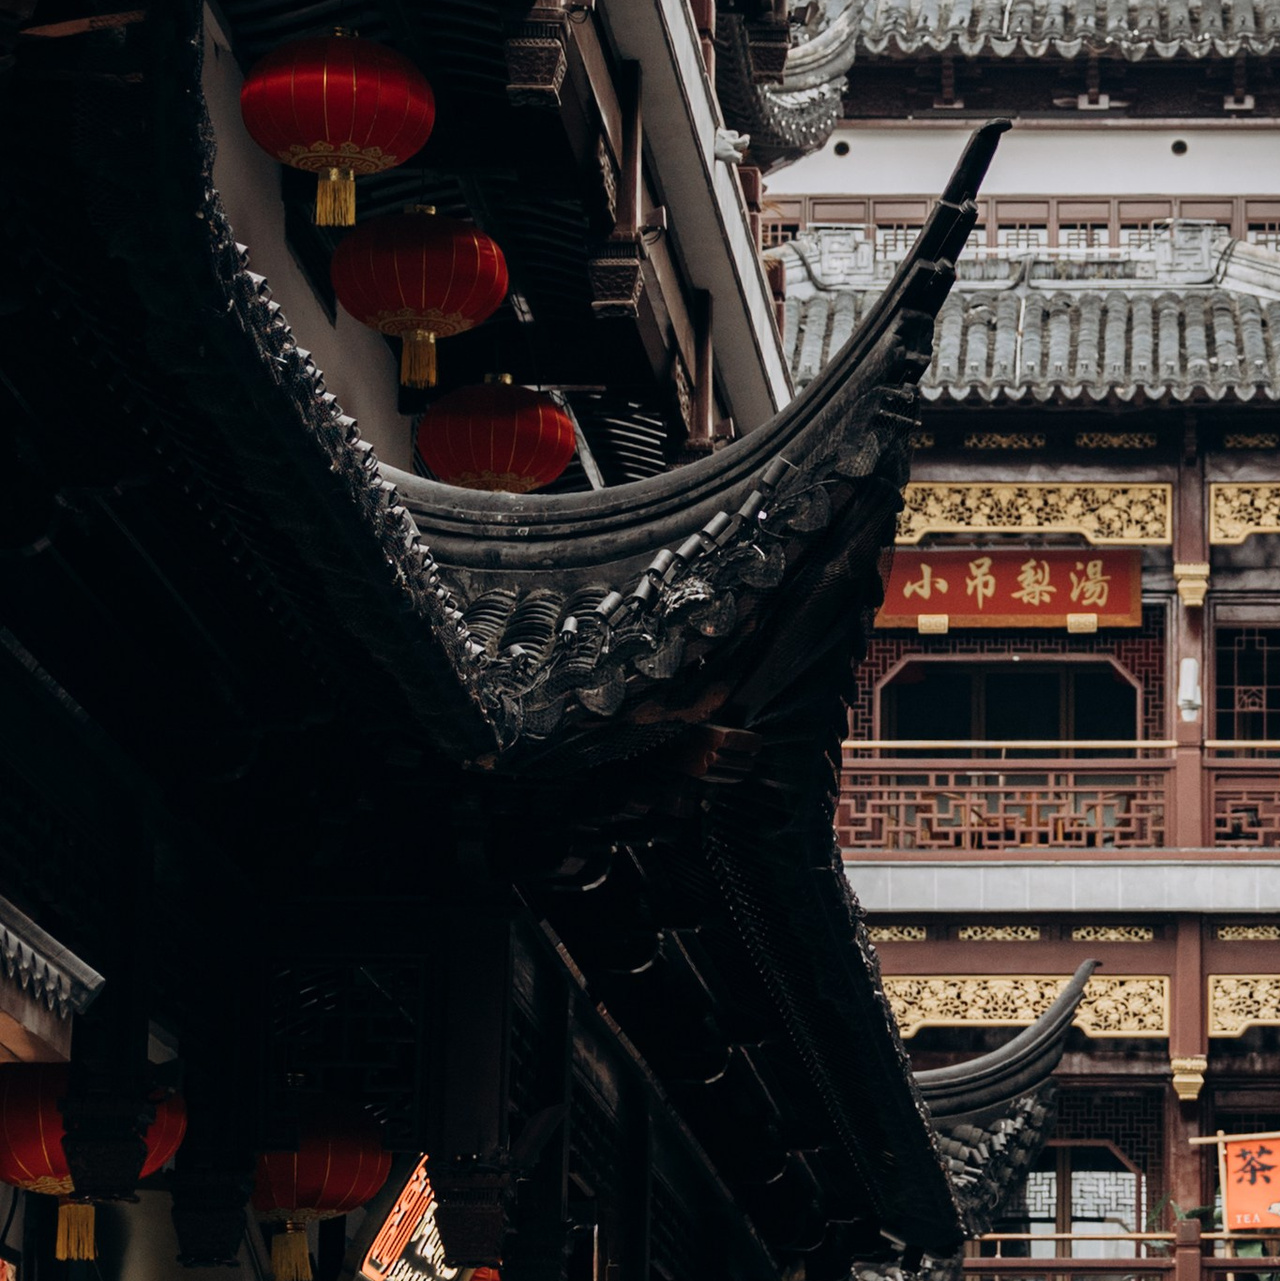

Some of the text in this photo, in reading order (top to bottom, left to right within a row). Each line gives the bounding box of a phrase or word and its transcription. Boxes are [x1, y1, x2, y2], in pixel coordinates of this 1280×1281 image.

[902, 556, 1112, 611] 小吊梨湯
[1233, 1145, 1278, 1186] 茶
[1236, 1213, 1261, 1225] TEA
